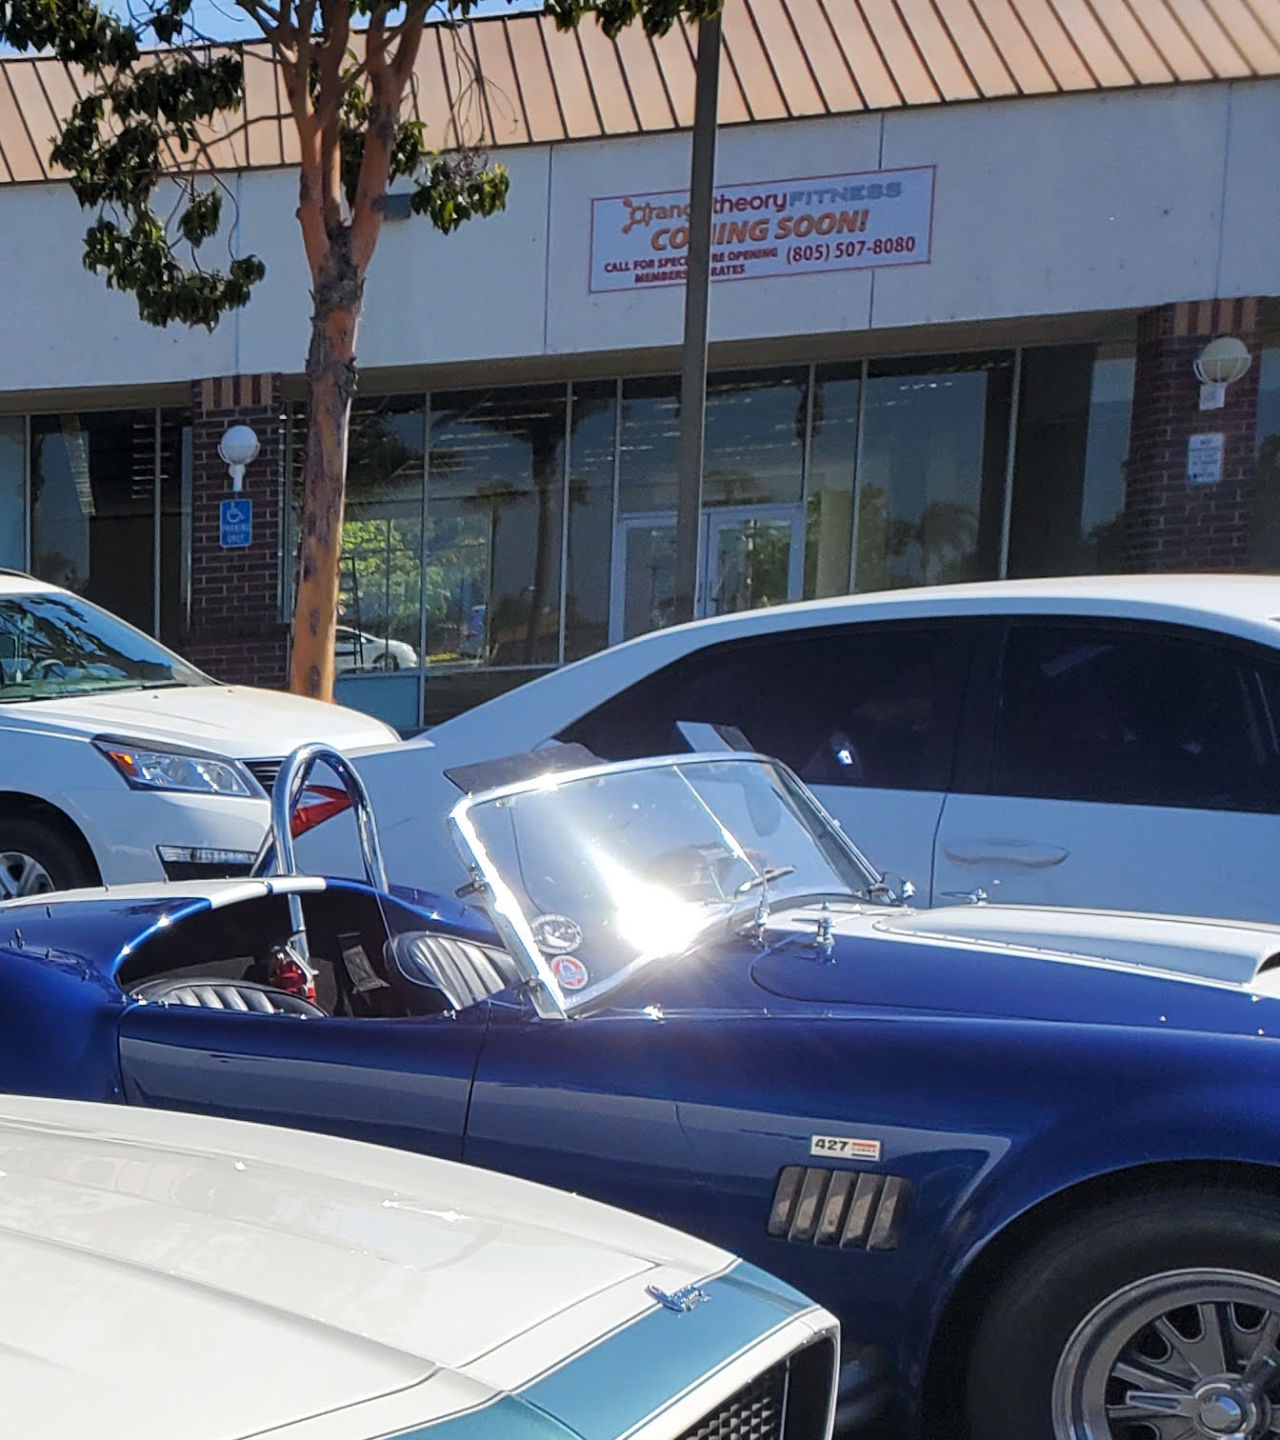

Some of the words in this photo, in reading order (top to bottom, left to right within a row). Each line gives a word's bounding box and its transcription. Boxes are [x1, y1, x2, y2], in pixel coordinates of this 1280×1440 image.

[622, 191, 787, 234] Orantheory
[651, 218, 770, 252] COING
[774, 208, 870, 239] SOON!
[604, 261, 630, 273] CALL
[633, 259, 655, 270] FOR
[658, 256, 688, 268] SPEC
[727, 247, 778, 261] OPENING
[786, 243, 830, 265] (805)
[834, 236, 916, 258] 507-8080
[634, 270, 688, 283] MEMBERS
[710, 264, 745, 276] RATES
[814, 1138, 850, 1151] 427
